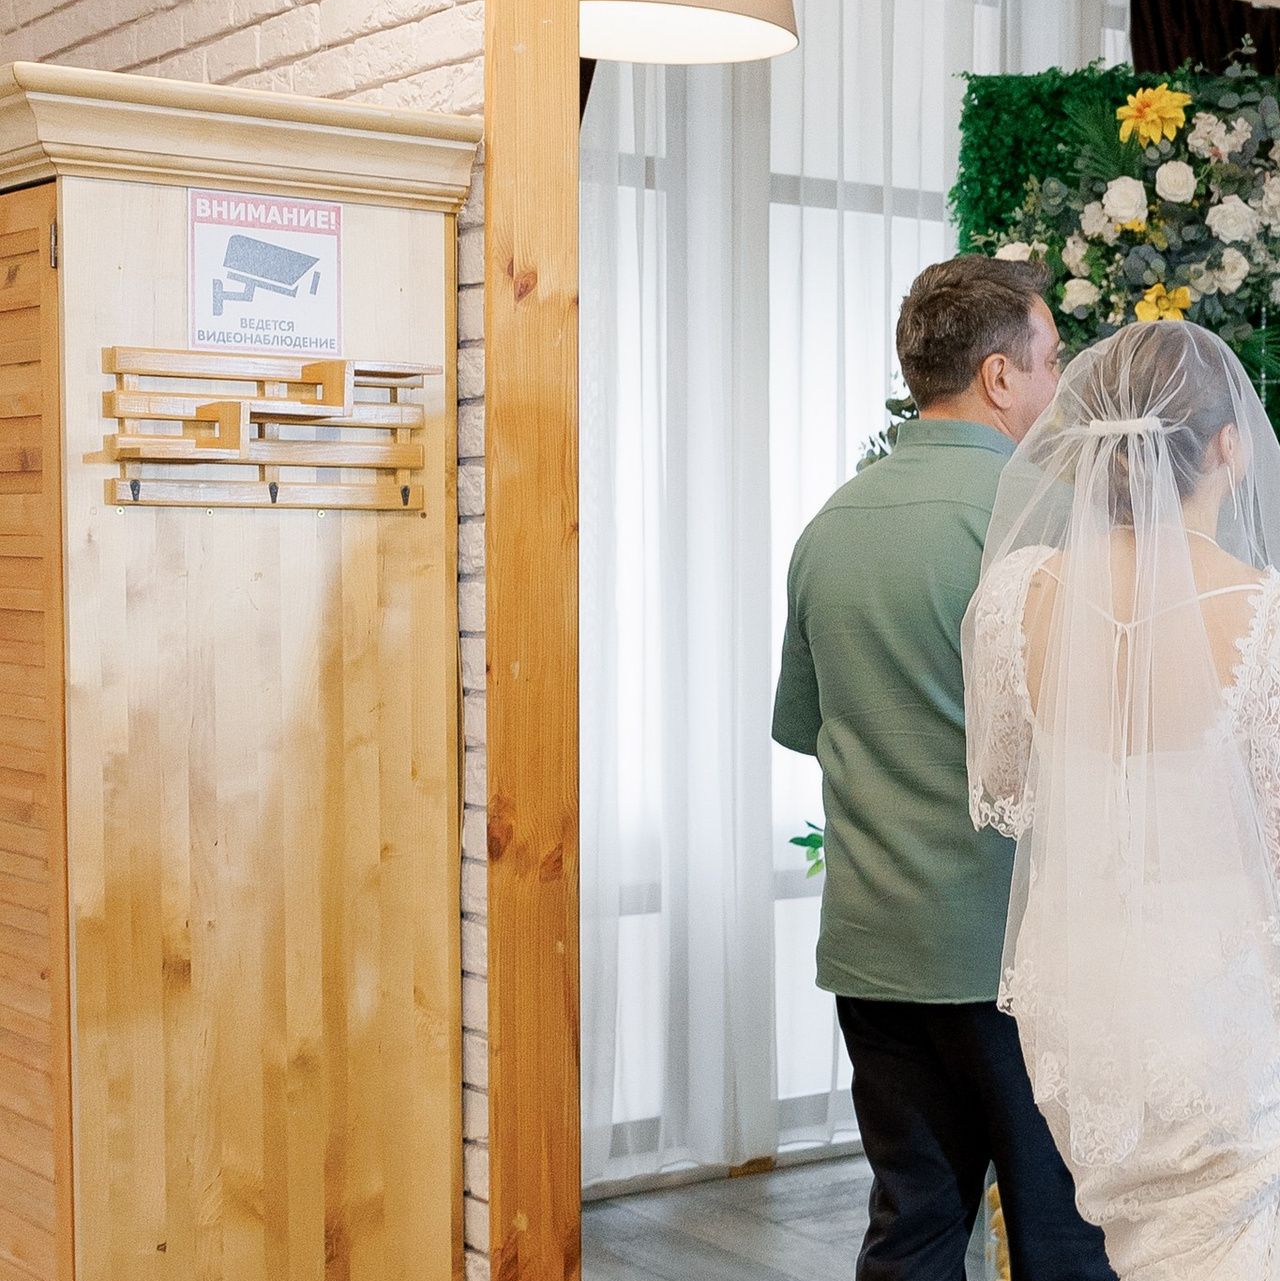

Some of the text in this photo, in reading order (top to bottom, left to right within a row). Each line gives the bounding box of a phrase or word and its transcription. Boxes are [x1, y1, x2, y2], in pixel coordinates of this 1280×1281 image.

[196, 197, 336, 230] ВНИМАНИЕ!
[240, 317, 295, 332] ВЕДЕТСЯ
[197, 329, 336, 350] ВИДЕОНАБЛЮДЕНИЕ
